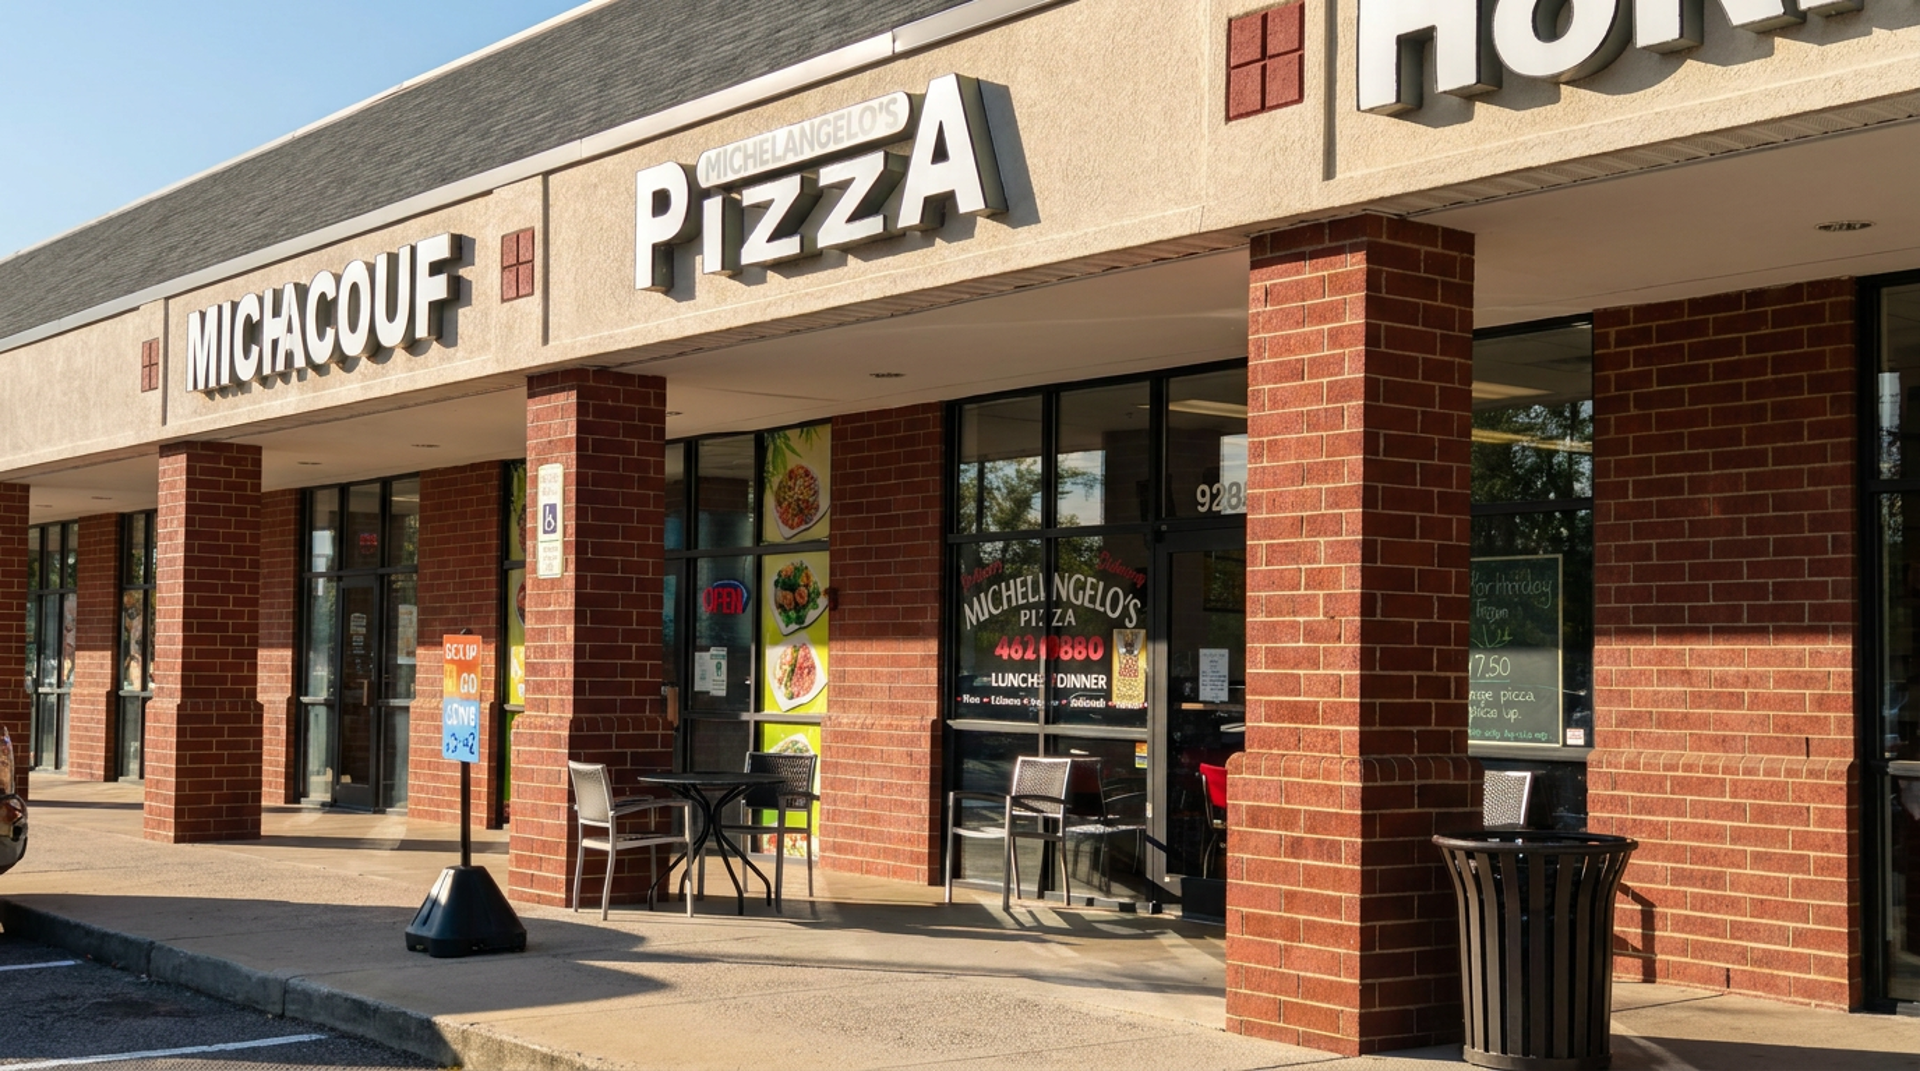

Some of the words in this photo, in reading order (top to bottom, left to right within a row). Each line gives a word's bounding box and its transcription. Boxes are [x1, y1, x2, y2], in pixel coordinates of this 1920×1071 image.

[704, 96, 900, 183] MICHELANGELO'S
[186, 232, 456, 392] MICHACOUF
[1196, 481, 1247, 512] 928
[991, 672, 1038, 688] LUNCH
[1057, 673, 1107, 689] DINNER
